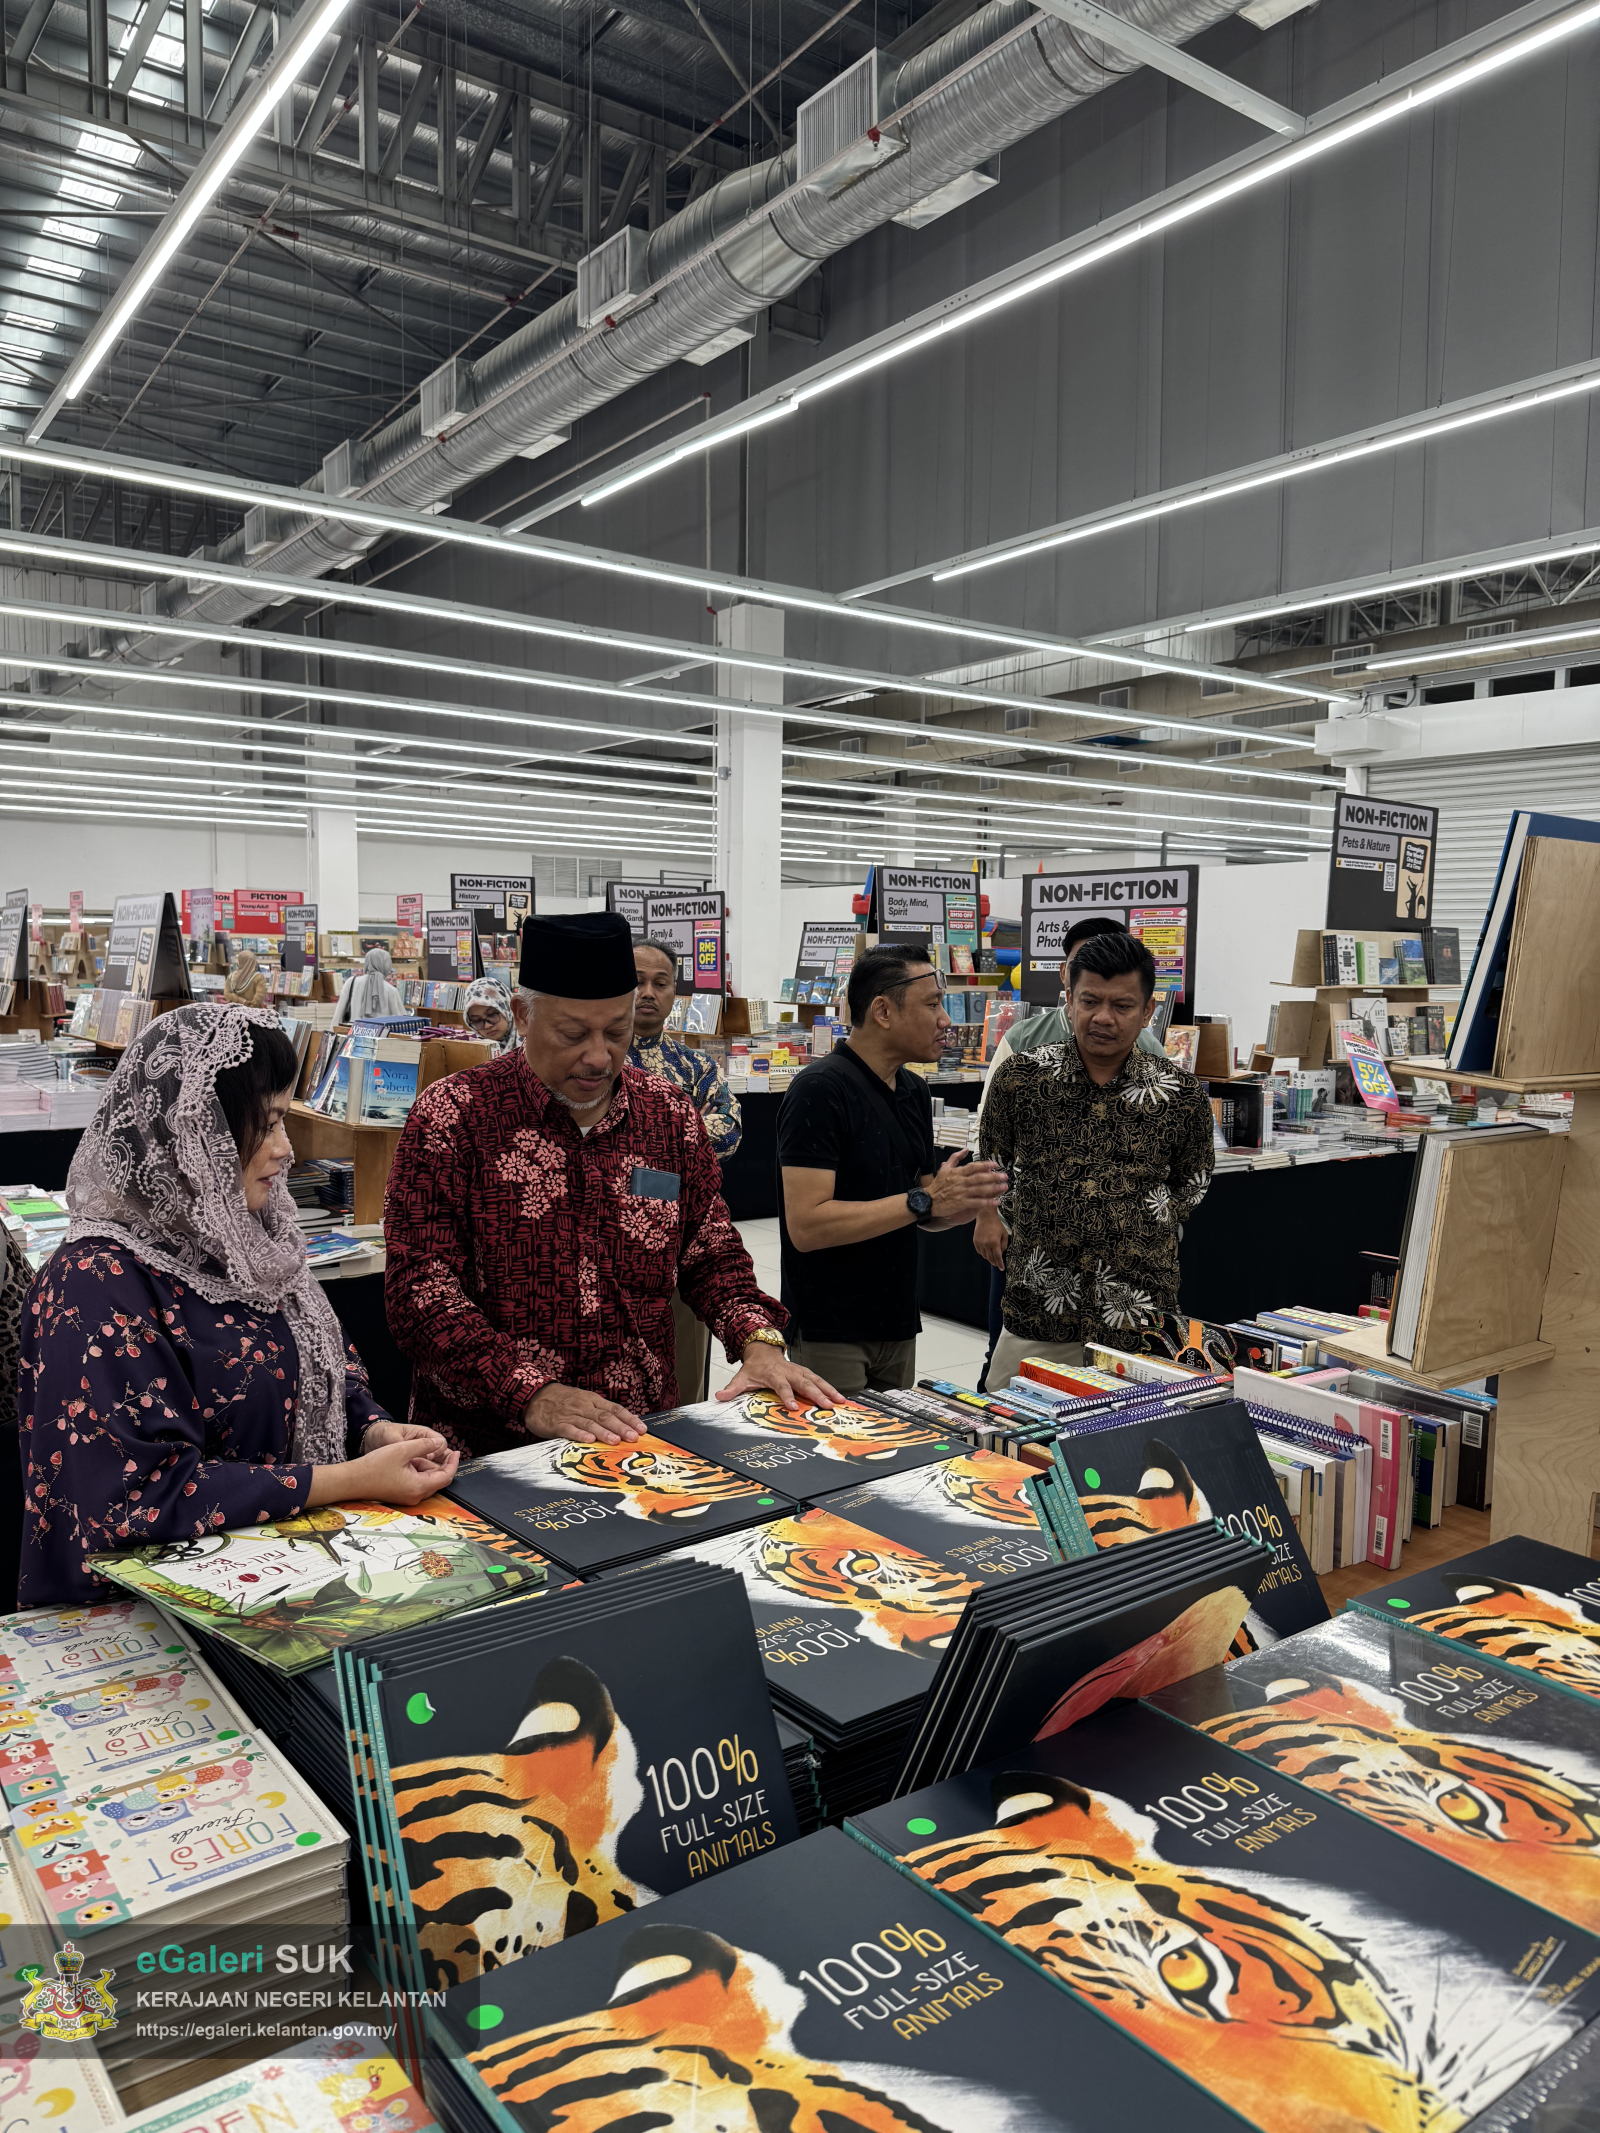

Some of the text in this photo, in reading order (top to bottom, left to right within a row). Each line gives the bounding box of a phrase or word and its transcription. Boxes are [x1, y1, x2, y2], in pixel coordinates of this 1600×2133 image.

[1345, 805, 1428, 832] NON-FICTION
[1342, 836, 1390, 852] Pets & Nature
[459, 879, 527, 889] NON-FICTION
[888, 874, 971, 890] NON-FICTION
[1039, 879, 1179, 903] NON-FICTION
[251, 893, 287, 901] FICTION
[651, 901, 716, 917] NON-FICTION
[888, 897, 929, 908] Body, Mind,
[117, 902, 158, 922] NON-FICTION
[288, 910, 314, 918] NON-FICTION
[431, 915, 469, 927] NON-FICTION
[888, 907, 908, 917] Spirit
[651, 929, 673, 940] Family &
[1036, 920, 1070, 933] Arts &
[699, 942, 716, 952] RM5
[806, 935, 855, 945] NON-FICTION
[699, 953, 716, 965] OFF
[383, 1069, 409, 1080] Nora
[1358, 1062, 1385, 1083] 5%
[1362, 1078, 1390, 1095] OFF
[724, 1442, 776, 1459] ANIMALS
[737, 1443, 797, 1463] FULL-SIZE
[746, 1447, 818, 1470] 100%
[1056, 1455, 1065, 1472] 100%
[1062, 1472, 1071, 1490] FULL
[1070, 1492, 1078, 1510] SIZE
[513, 1496, 576, 1518] ANIMALS
[522, 1498, 599, 1523] FULL-SIZE
[534, 1503, 618, 1532] 100%
[1220, 1503, 1283, 1543] 00%
[945, 1535, 1004, 1558] ANIMALS
[957, 1537, 1029, 1565] FULL-SIZE
[977, 1544, 1052, 1576] 100%
[1257, 1563, 1302, 1594] ANIMALS
[755, 1616, 804, 1638] ANIMA
[757, 1619, 832, 1651] FULL-SIZ
[62, 1630, 132, 1652] Friends
[765, 1628, 861, 1666] 100%
[41, 1635, 162, 1675] FOREST
[1389, 1663, 1484, 1706] 100%
[1436, 1678, 1515, 1719] FULL-SIZE
[1473, 1689, 1539, 1724] ANIMALS
[105, 1710, 183, 1736] Friends
[83, 1714, 216, 1766] FOREST
[372, 1704, 380, 1729] 100%
[376, 1732, 385, 1758] FULL
[381, 1761, 390, 1786] SIZE
[646, 1733, 760, 1818] 100%
[1145, 1772, 1261, 1831] 100%
[169, 1808, 256, 1844] Friends
[660, 1789, 770, 1853] FULL-SIZE
[1192, 1792, 1293, 1849] FULL-SIZE
[1234, 1808, 1318, 1855] ANIMALS
[147, 1813, 299, 1885] FOREST
[688, 1821, 777, 1878] ANIMALS
[798, 1922, 947, 2006] 100%
[842, 1950, 979, 2031] FULL-SIZE
[892, 1972, 1004, 2041] ANIMALS
